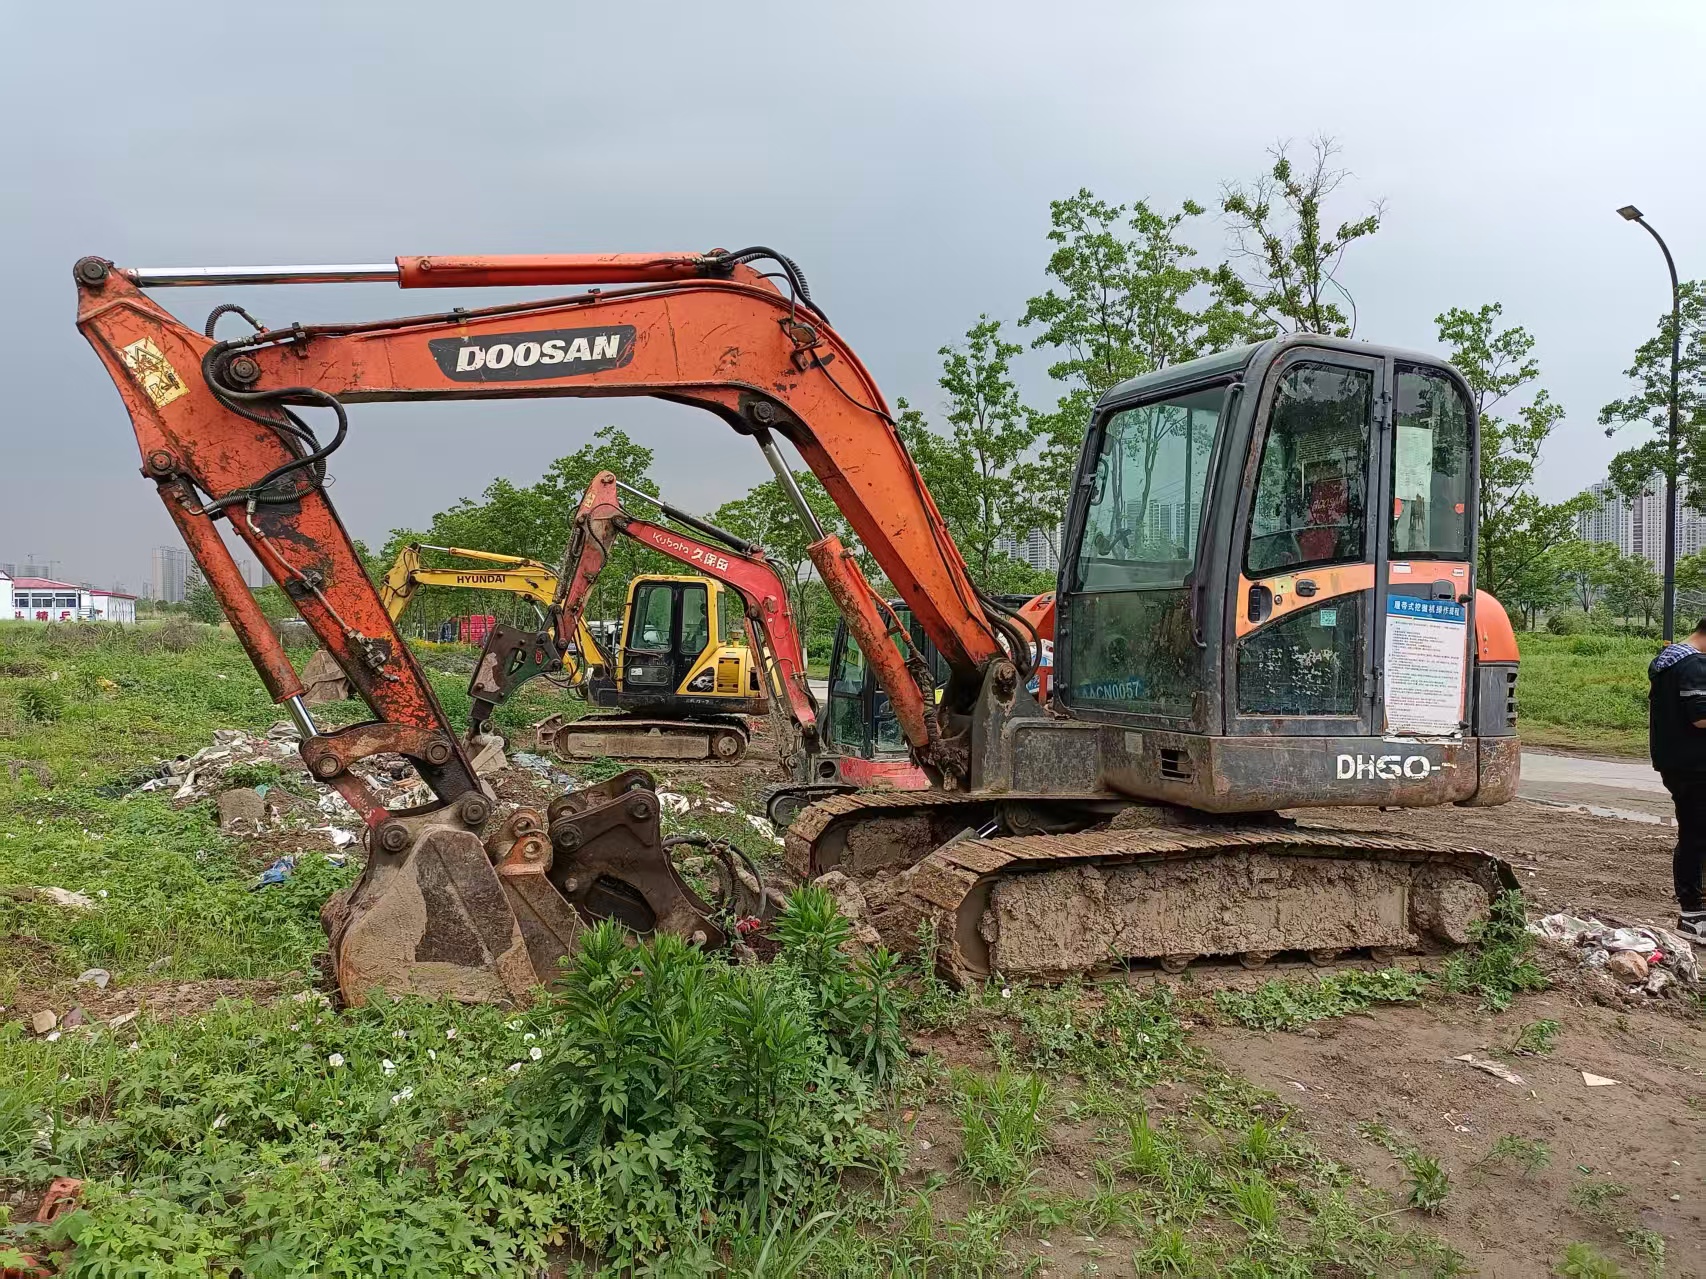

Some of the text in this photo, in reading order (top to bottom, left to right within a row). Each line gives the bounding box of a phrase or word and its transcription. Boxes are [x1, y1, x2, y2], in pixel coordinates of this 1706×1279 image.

[456, 335, 620, 372] DOOSAN
[653, 532, 729, 572] Kubota 久保田
[457, 575, 506, 583] HYUNDAI
